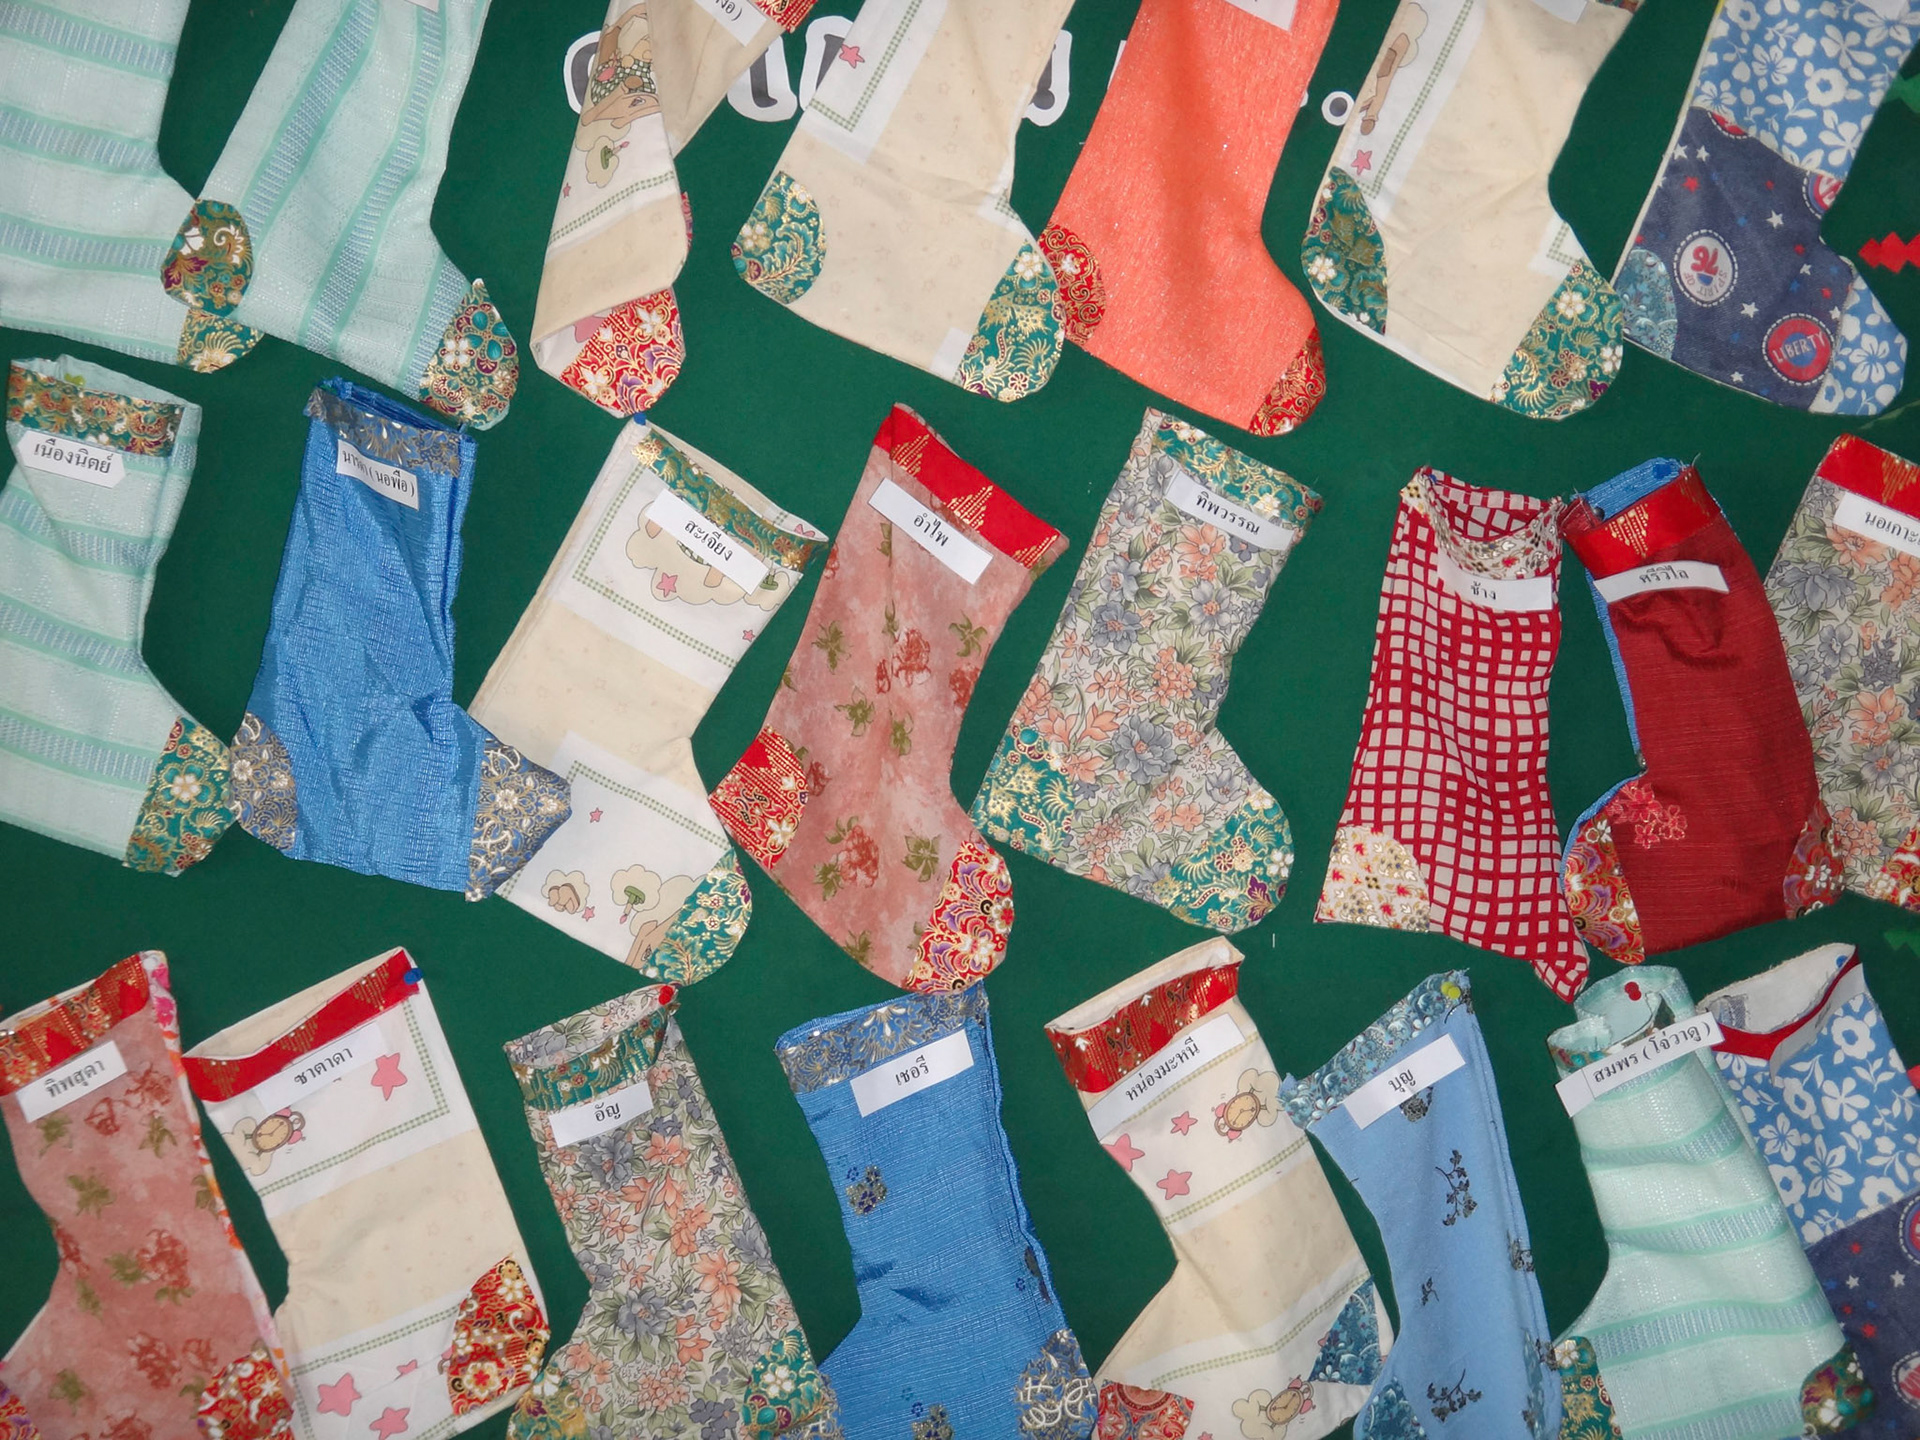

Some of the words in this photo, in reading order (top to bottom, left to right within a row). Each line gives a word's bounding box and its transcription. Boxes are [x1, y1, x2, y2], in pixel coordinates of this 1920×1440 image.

[1690, 245, 1719, 276] 76
[1697, 270, 1727, 296] SPIRIT
[1772, 331, 1825, 363] LIBERTY
[1195, 491, 1261, 535] ทิพวรรณ
[1865, 511, 1920, 546] นอเกาะ
[685, 520, 733, 561] สะเจียง
[913, 513, 950, 548] อำไพ
[1470, 581, 1496, 601] ช้าง
[895, 1054, 929, 1086] เชอรี
[1388, 1069, 1416, 1093] บุญ
[594, 1101, 621, 1122] อัญ
